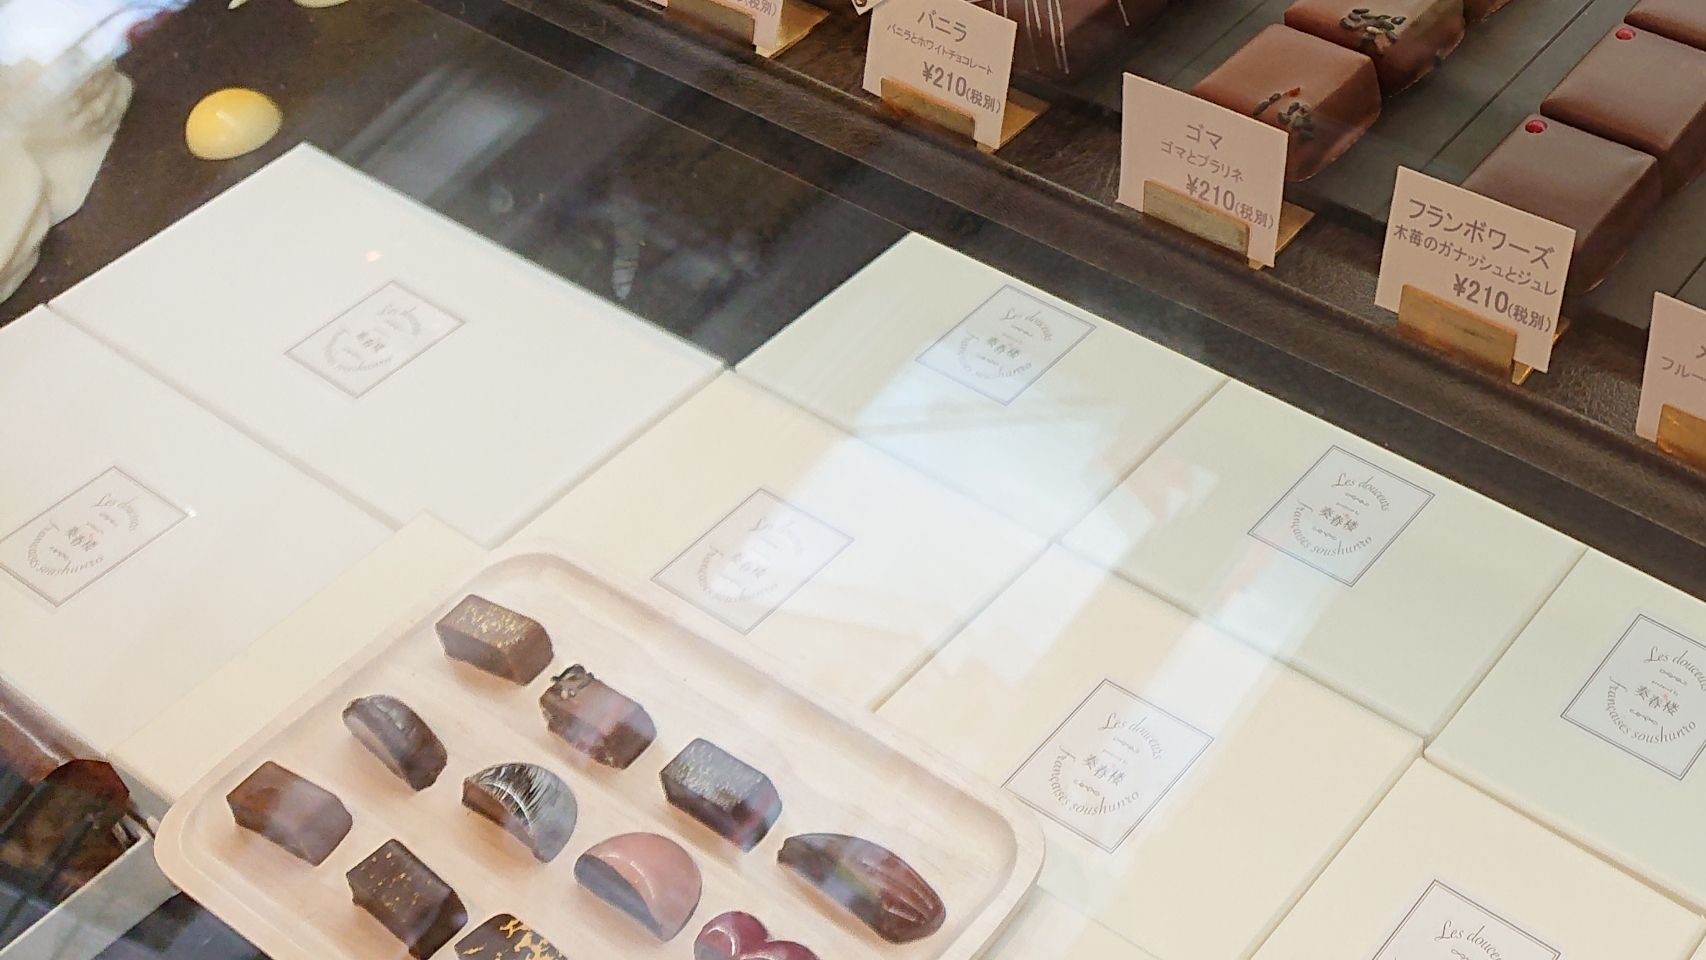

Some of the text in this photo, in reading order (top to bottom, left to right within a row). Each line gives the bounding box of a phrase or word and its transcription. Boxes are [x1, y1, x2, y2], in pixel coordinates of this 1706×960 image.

[922, 61, 1001, 114] ¥210(税別)
[1161, 140, 1244, 182] ゴマとプラリネ
[1186, 124, 1223, 150] ゴマ
[1186, 174, 1274, 229] ¥210(税別)
[1394, 224, 1557, 296] 木苺のガナッシュとジュレ
[1409, 198, 1555, 269] フランボワーズ
[1453, 273, 1551, 332] ¥210(税別)
[1643, 646, 1669, 663] Les
[1434, 920, 1464, 942] Les
